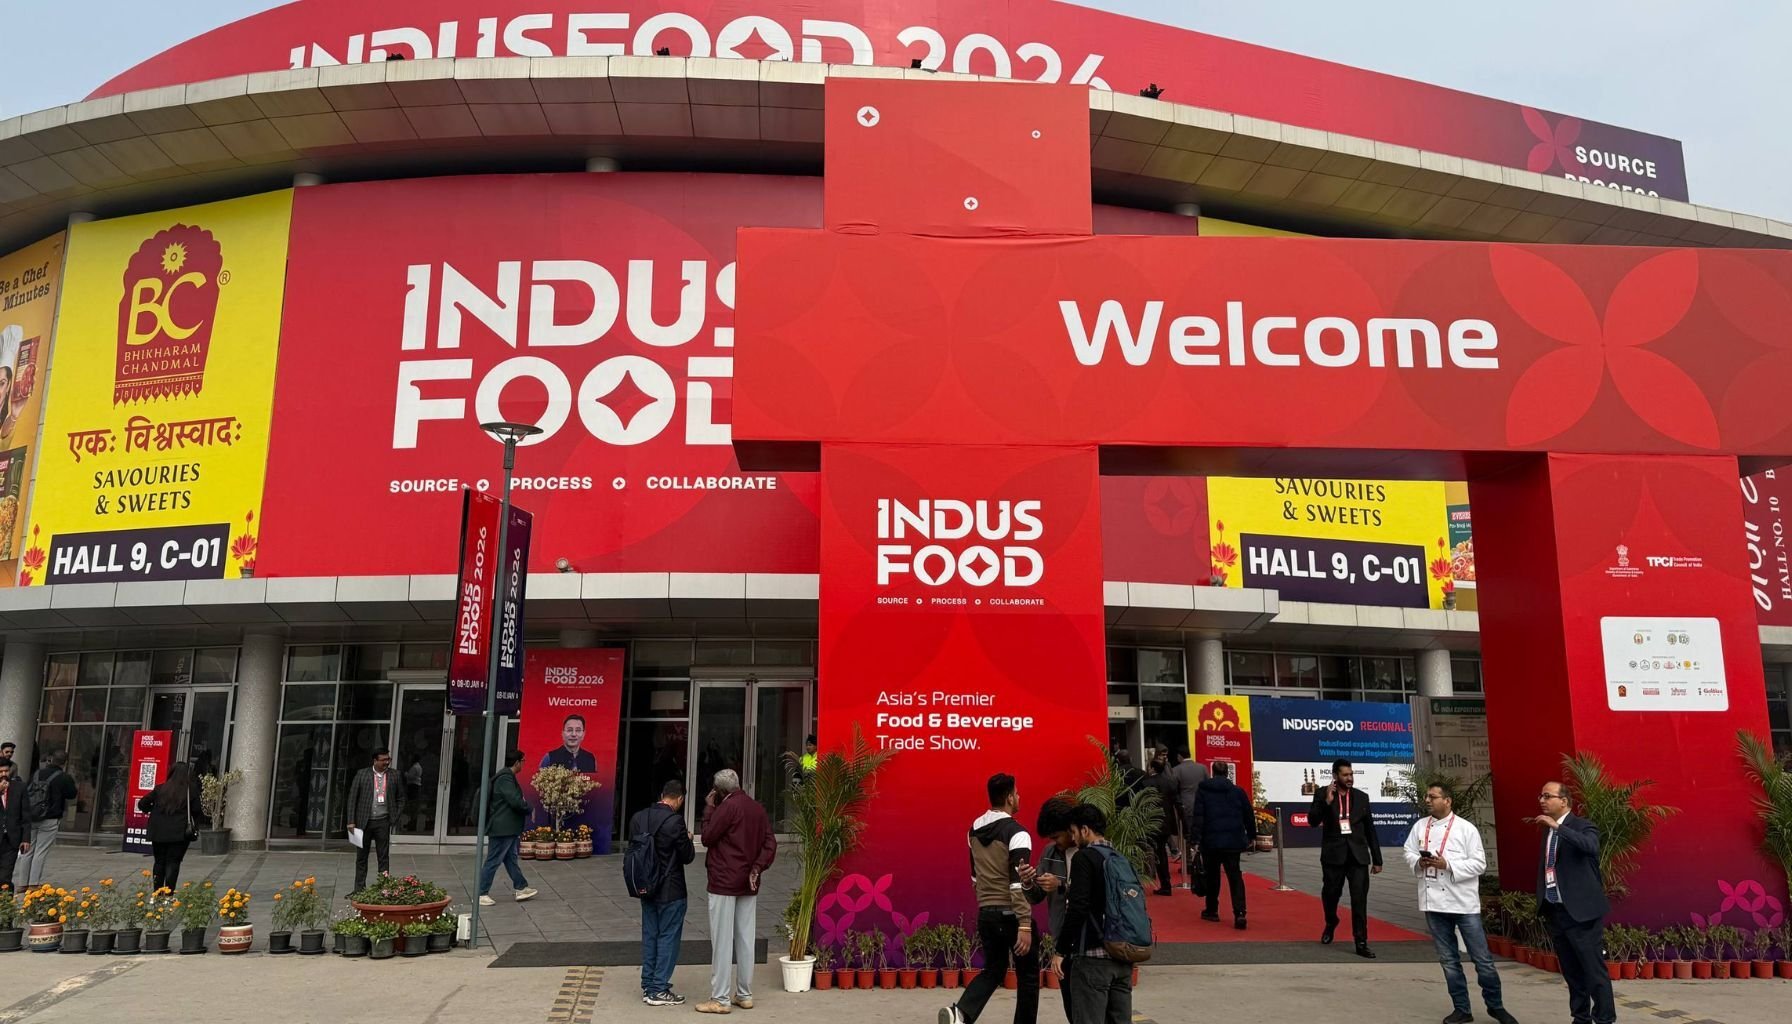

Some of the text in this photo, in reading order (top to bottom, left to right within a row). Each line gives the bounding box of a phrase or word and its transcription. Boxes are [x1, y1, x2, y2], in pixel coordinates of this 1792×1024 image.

[1575, 146, 1657, 179] SOURCE
[12, 277, 19, 290] a
[22, 261, 50, 286] Chef
[3, 282, 51, 312] Minutes
[126, 271, 207, 346] BC
[1058, 299, 1499, 369] Welcome
[122, 356, 200, 375] CHANDMAL
[124, 343, 202, 362] BHIKHARAM
[122, 383, 191, 400] BIKANER
[93, 462, 201, 490] SAVOURIES
[389, 475, 777, 493] SOURCE PROCESS COLLABORATE
[95, 490, 191, 515] & SWEETS
[1274, 478, 1387, 502] SAVOURIES
[1282, 500, 1383, 527] & SWEETS
[1768, 496, 1781, 513] 10
[877, 498, 1044, 541] INDUS
[1772, 518, 1786, 548] NO.
[52, 537, 221, 576] HALL 9, C-01
[474, 525, 488, 582] 2026
[877, 544, 1044, 587] FOOD
[1248, 546, 1421, 585] HALL 9, C-01
[1646, 556, 1674, 568] TPCI
[1776, 551, 1792, 601] HALL
[506, 547, 521, 669] FOOD 2026
[876, 597, 909, 605] SOURCE
[989, 598, 1045, 606] COLLABORATE
[459, 582, 474, 655] INDUS
[468, 585, 482, 656] FOOD
[500, 600, 511, 668] INDUS
[544, 675, 604, 685] FOOD 2026
[545, 666, 578, 676] INDUS
[548, 696, 598, 707] Welcome
[876, 691, 996, 706] Asia's Premier
[876, 713, 1034, 732] Food & Beverage
[1282, 718, 1354, 732] INDUSFOOD
[1360, 721, 1407, 732] REGIONAL
[876, 734, 981, 750] Trade Show.
[1438, 753, 1468, 768] Halls
